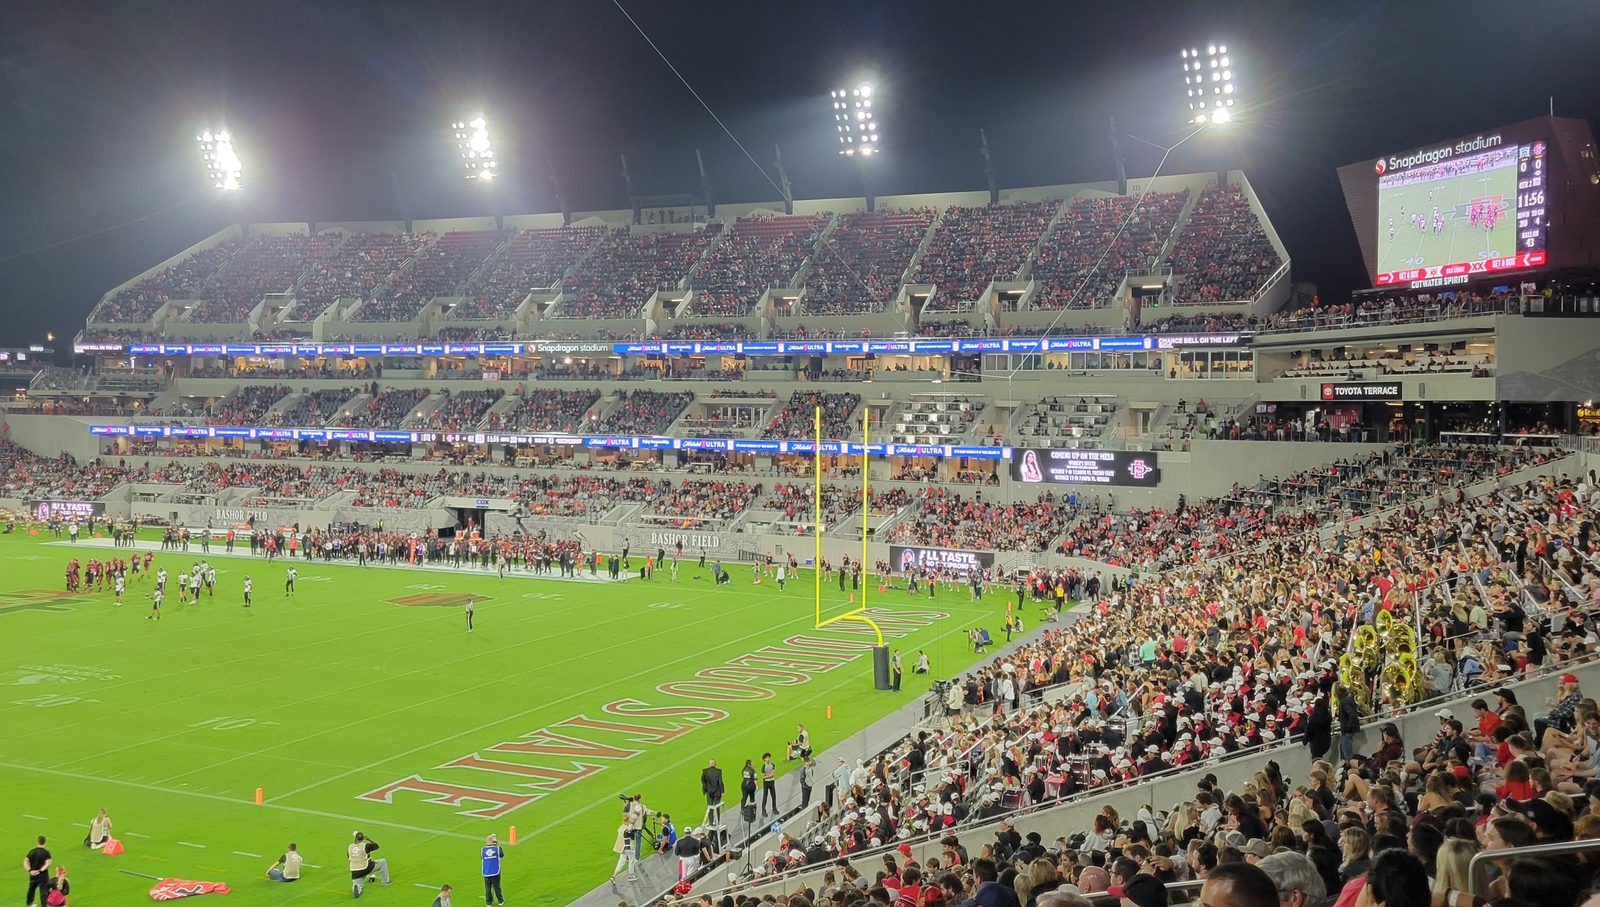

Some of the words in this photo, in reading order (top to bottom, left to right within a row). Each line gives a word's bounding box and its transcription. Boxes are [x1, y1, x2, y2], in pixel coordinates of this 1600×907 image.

[1389, 147, 1452, 170] Snapdragon
[1455, 135, 1501, 155] stadium
[1518, 191, 1544, 208] 11:56
[1411, 276, 1442, 289] CUTWATER
[1443, 275, 1468, 285] SPIRITS
[1158, 336, 1183, 344] CHANCE
[1184, 336, 1199, 344] BELL
[1223, 335, 1239, 343] LEFT
[537, 343, 579, 353] Snapdragon
[580, 343, 608, 352] stadium
[1335, 387, 1362, 396] TOYOTA
[1363, 386, 1398, 395] TERRACE
[706, 440, 725, 448] ULTRA
[922, 446, 942, 454] ULTRA
[1071, 452, 1080, 460] UP
[216, 509, 245, 521] BASHOR
[651, 532, 688, 546] BASHOR
[692, 535, 719, 548] FIELD
[940, 551, 977, 564] TASTE.
[655, 634, 890, 702] DIEGO
[354, 697, 731, 820] STATE
